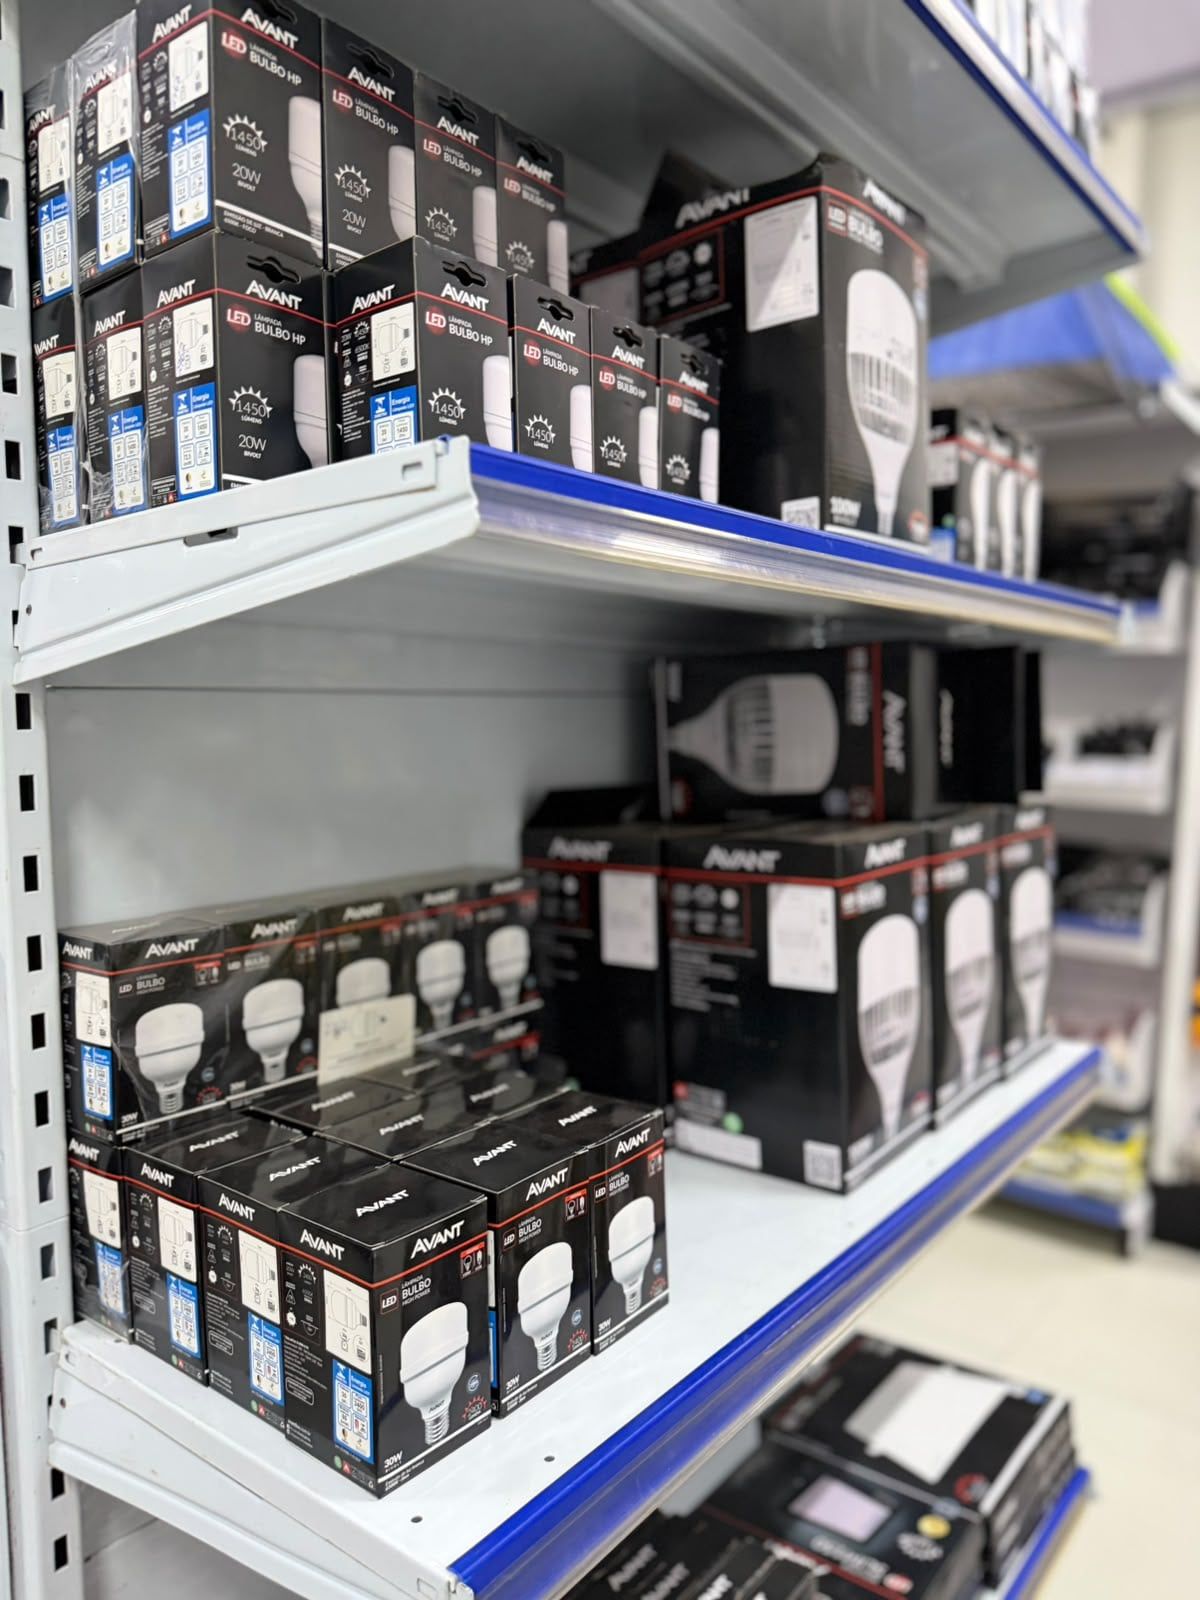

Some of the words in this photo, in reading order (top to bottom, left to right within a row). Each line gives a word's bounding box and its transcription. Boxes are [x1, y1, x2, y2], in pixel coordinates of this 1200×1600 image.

[152, 4, 192, 43] AVANT
[241, 8, 298, 49] AVANT
[221, 32, 247, 54] LED
[249, 51, 286, 78] BULBO
[287, 70, 302, 86] HP
[348, 67, 395, 102] AVANT
[332, 89, 353, 110] LED
[355, 105, 385, 131] BULBO
[387, 122, 399, 137] HP
[437, 116, 479, 147] AVANT
[231, 127, 262, 151] 1450
[423, 138, 442, 156] LED
[231, 161, 263, 187] 20W
[443, 151, 470, 176] BULBO
[470, 165, 483, 178] HP
[516, 156, 553, 183] AVANT
[340, 175, 368, 198] 1450
[504, 177, 521, 195] LED
[342, 208, 367, 229] 20W
[430, 217, 456, 238] 1450
[157, 279, 196, 308] AVANT
[246, 279, 303, 311] AVANT
[352, 284, 395, 314] AVANT
[441, 282, 490, 312] AVANT
[94, 310, 126, 338] AVANT
[226, 307, 251, 326] LED
[425, 311, 447, 329] LED
[254, 321, 291, 341] BULBO
[291, 332, 306, 346] HP
[449, 323, 480, 342] BULBO
[480, 333, 493, 346] HP
[537, 318, 576, 345] AVANT
[523, 343, 541, 361] LED
[612, 345, 645, 370] AVANT
[543, 355, 570, 375] BULBO
[569, 365, 579, 377] HP
[599, 370, 616, 386] LED
[616, 379, 638, 396] BULBO
[679, 370, 710, 396] AVANT
[236, 399, 267, 418] 1450
[434, 400, 462, 419] 1450
[667, 392, 682, 409] LED
[238, 434, 267, 452] 20W
[530, 428, 553, 443] 1450
[604, 449, 625, 463] 1450
[704, 845, 781, 873] AVANT
[251, 918, 298, 939] AVANT
[62, 941, 93, 960] AVANT
[145, 938, 199, 959] AVANT
[119, 984, 133, 994] LED
[137, 978, 165, 990] BULBO
[69, 1138, 100, 1162] AVANT
[615, 1128, 651, 1158] AVANT
[141, 1163, 175, 1188] AVANT
[526, 1168, 569, 1201] AVANT
[609, 1174, 630, 1192] BULBO
[595, 1185, 607, 1198] LED
[218, 1193, 256, 1221] AVANT
[356, 1189, 410, 1217] AVANT
[503, 1233, 515, 1246] LED
[518, 1219, 542, 1238] BULBO
[300, 1229, 345, 1261] AVANT
[410, 1220, 465, 1260] AVANT
[402, 1278, 432, 1300] BULBO
[382, 1295, 397, 1309] LED
[505, 1374, 521, 1391] 30W
[384, 1450, 403, 1469] 30W
